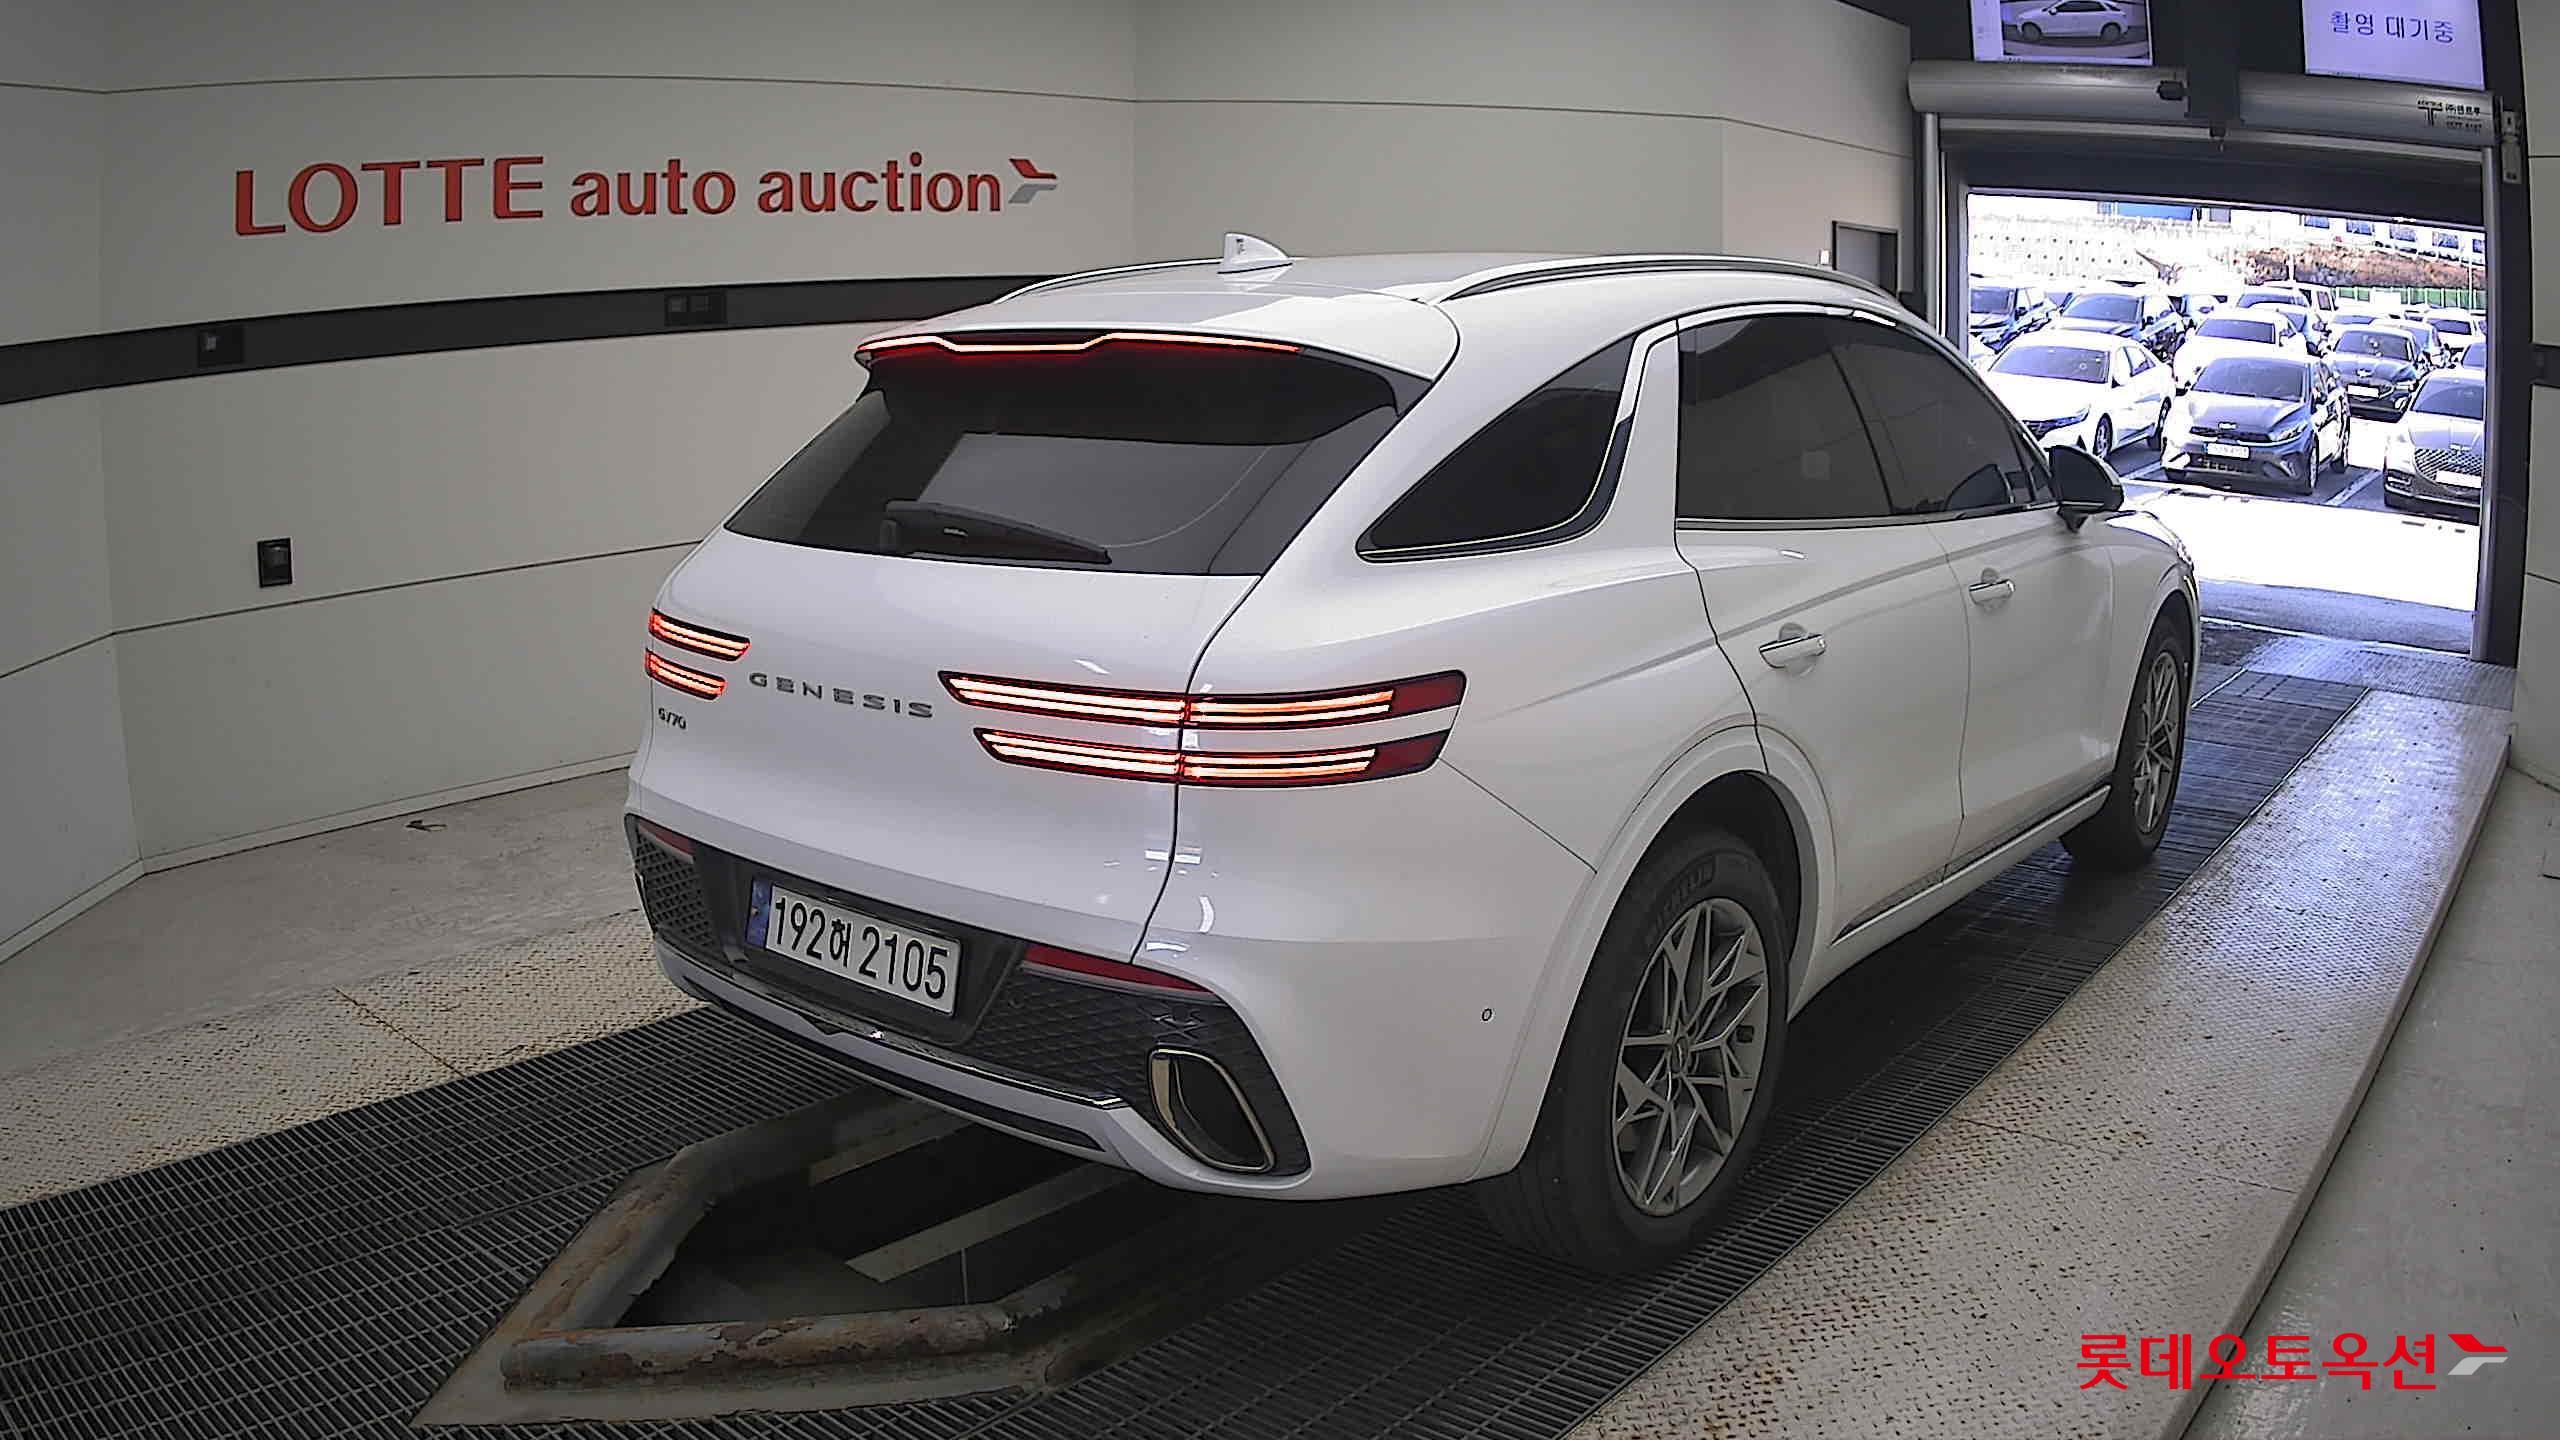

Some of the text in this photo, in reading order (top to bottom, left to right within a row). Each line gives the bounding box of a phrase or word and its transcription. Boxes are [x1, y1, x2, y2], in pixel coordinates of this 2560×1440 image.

[2330, 11, 2454, 44] 촬영 대기중
[235, 151, 1001, 236] LOTTE auto auction
[749, 672, 933, 718] GENESIS
[775, 897, 950, 1000] 192허 2105
